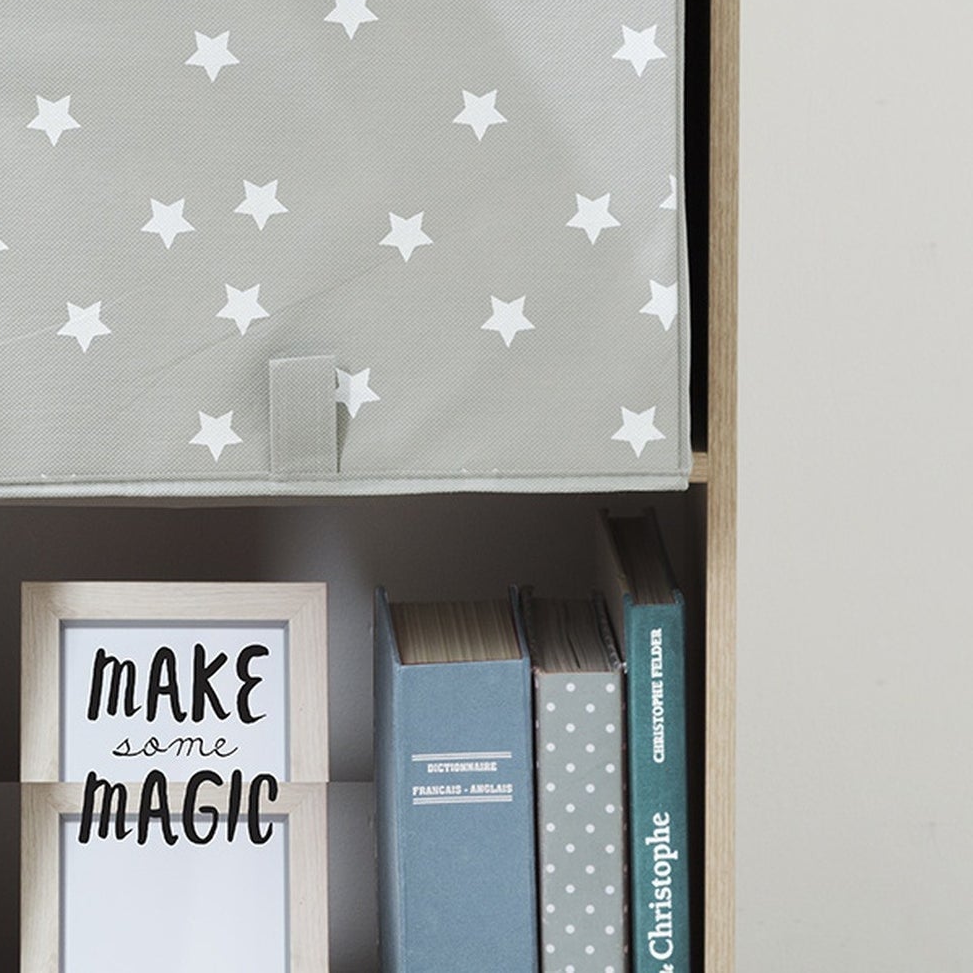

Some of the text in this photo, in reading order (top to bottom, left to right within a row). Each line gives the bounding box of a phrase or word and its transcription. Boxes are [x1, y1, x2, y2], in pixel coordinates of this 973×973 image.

[87, 643, 270, 724] MAKE
[650, 628, 665, 763] CHRISTOPHE FELDER
[112, 736, 239, 758] some
[427, 762, 497, 773] DICTIONNAIRE
[78, 769, 278, 846] MAGIC
[470, 784, 513, 794] ANGLAIS
[645, 812, 678, 960] Christophe
